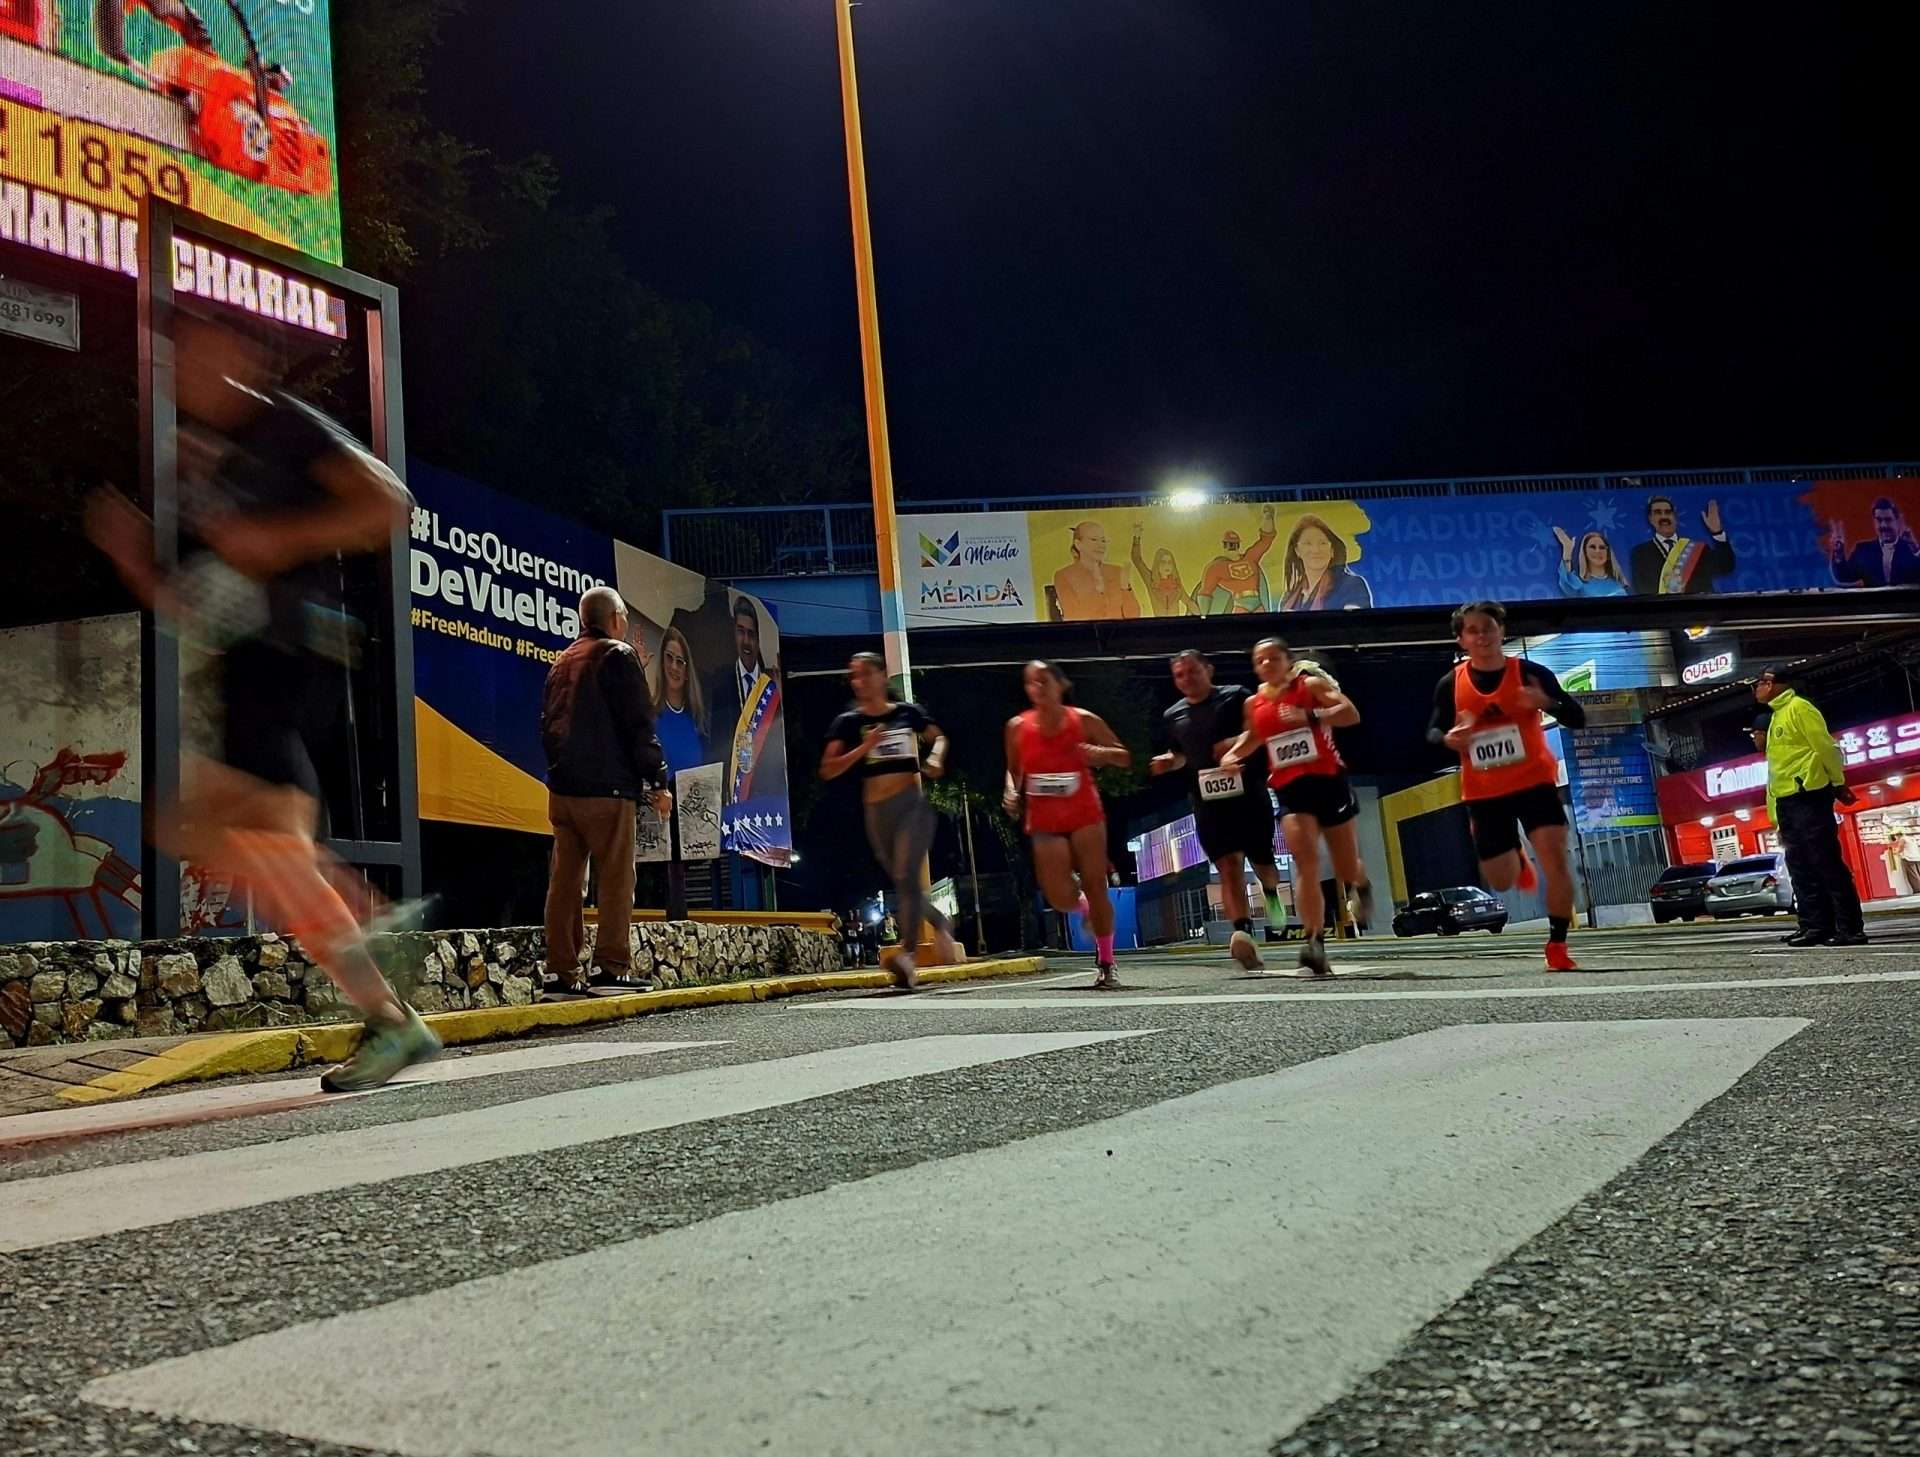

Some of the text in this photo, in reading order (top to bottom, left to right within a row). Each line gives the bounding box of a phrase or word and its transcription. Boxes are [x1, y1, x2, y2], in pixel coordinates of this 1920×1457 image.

[40, 124, 192, 206] 1859
[1370, 509, 1541, 544] MADURO
[964, 542, 1019, 565] Mérida
[1372, 548, 1548, 582] MADURO
[410, 548, 581, 640] DeVuelta
[410, 607, 512, 652] #FreeMaduro
[1204, 777, 1237, 795] 0352
